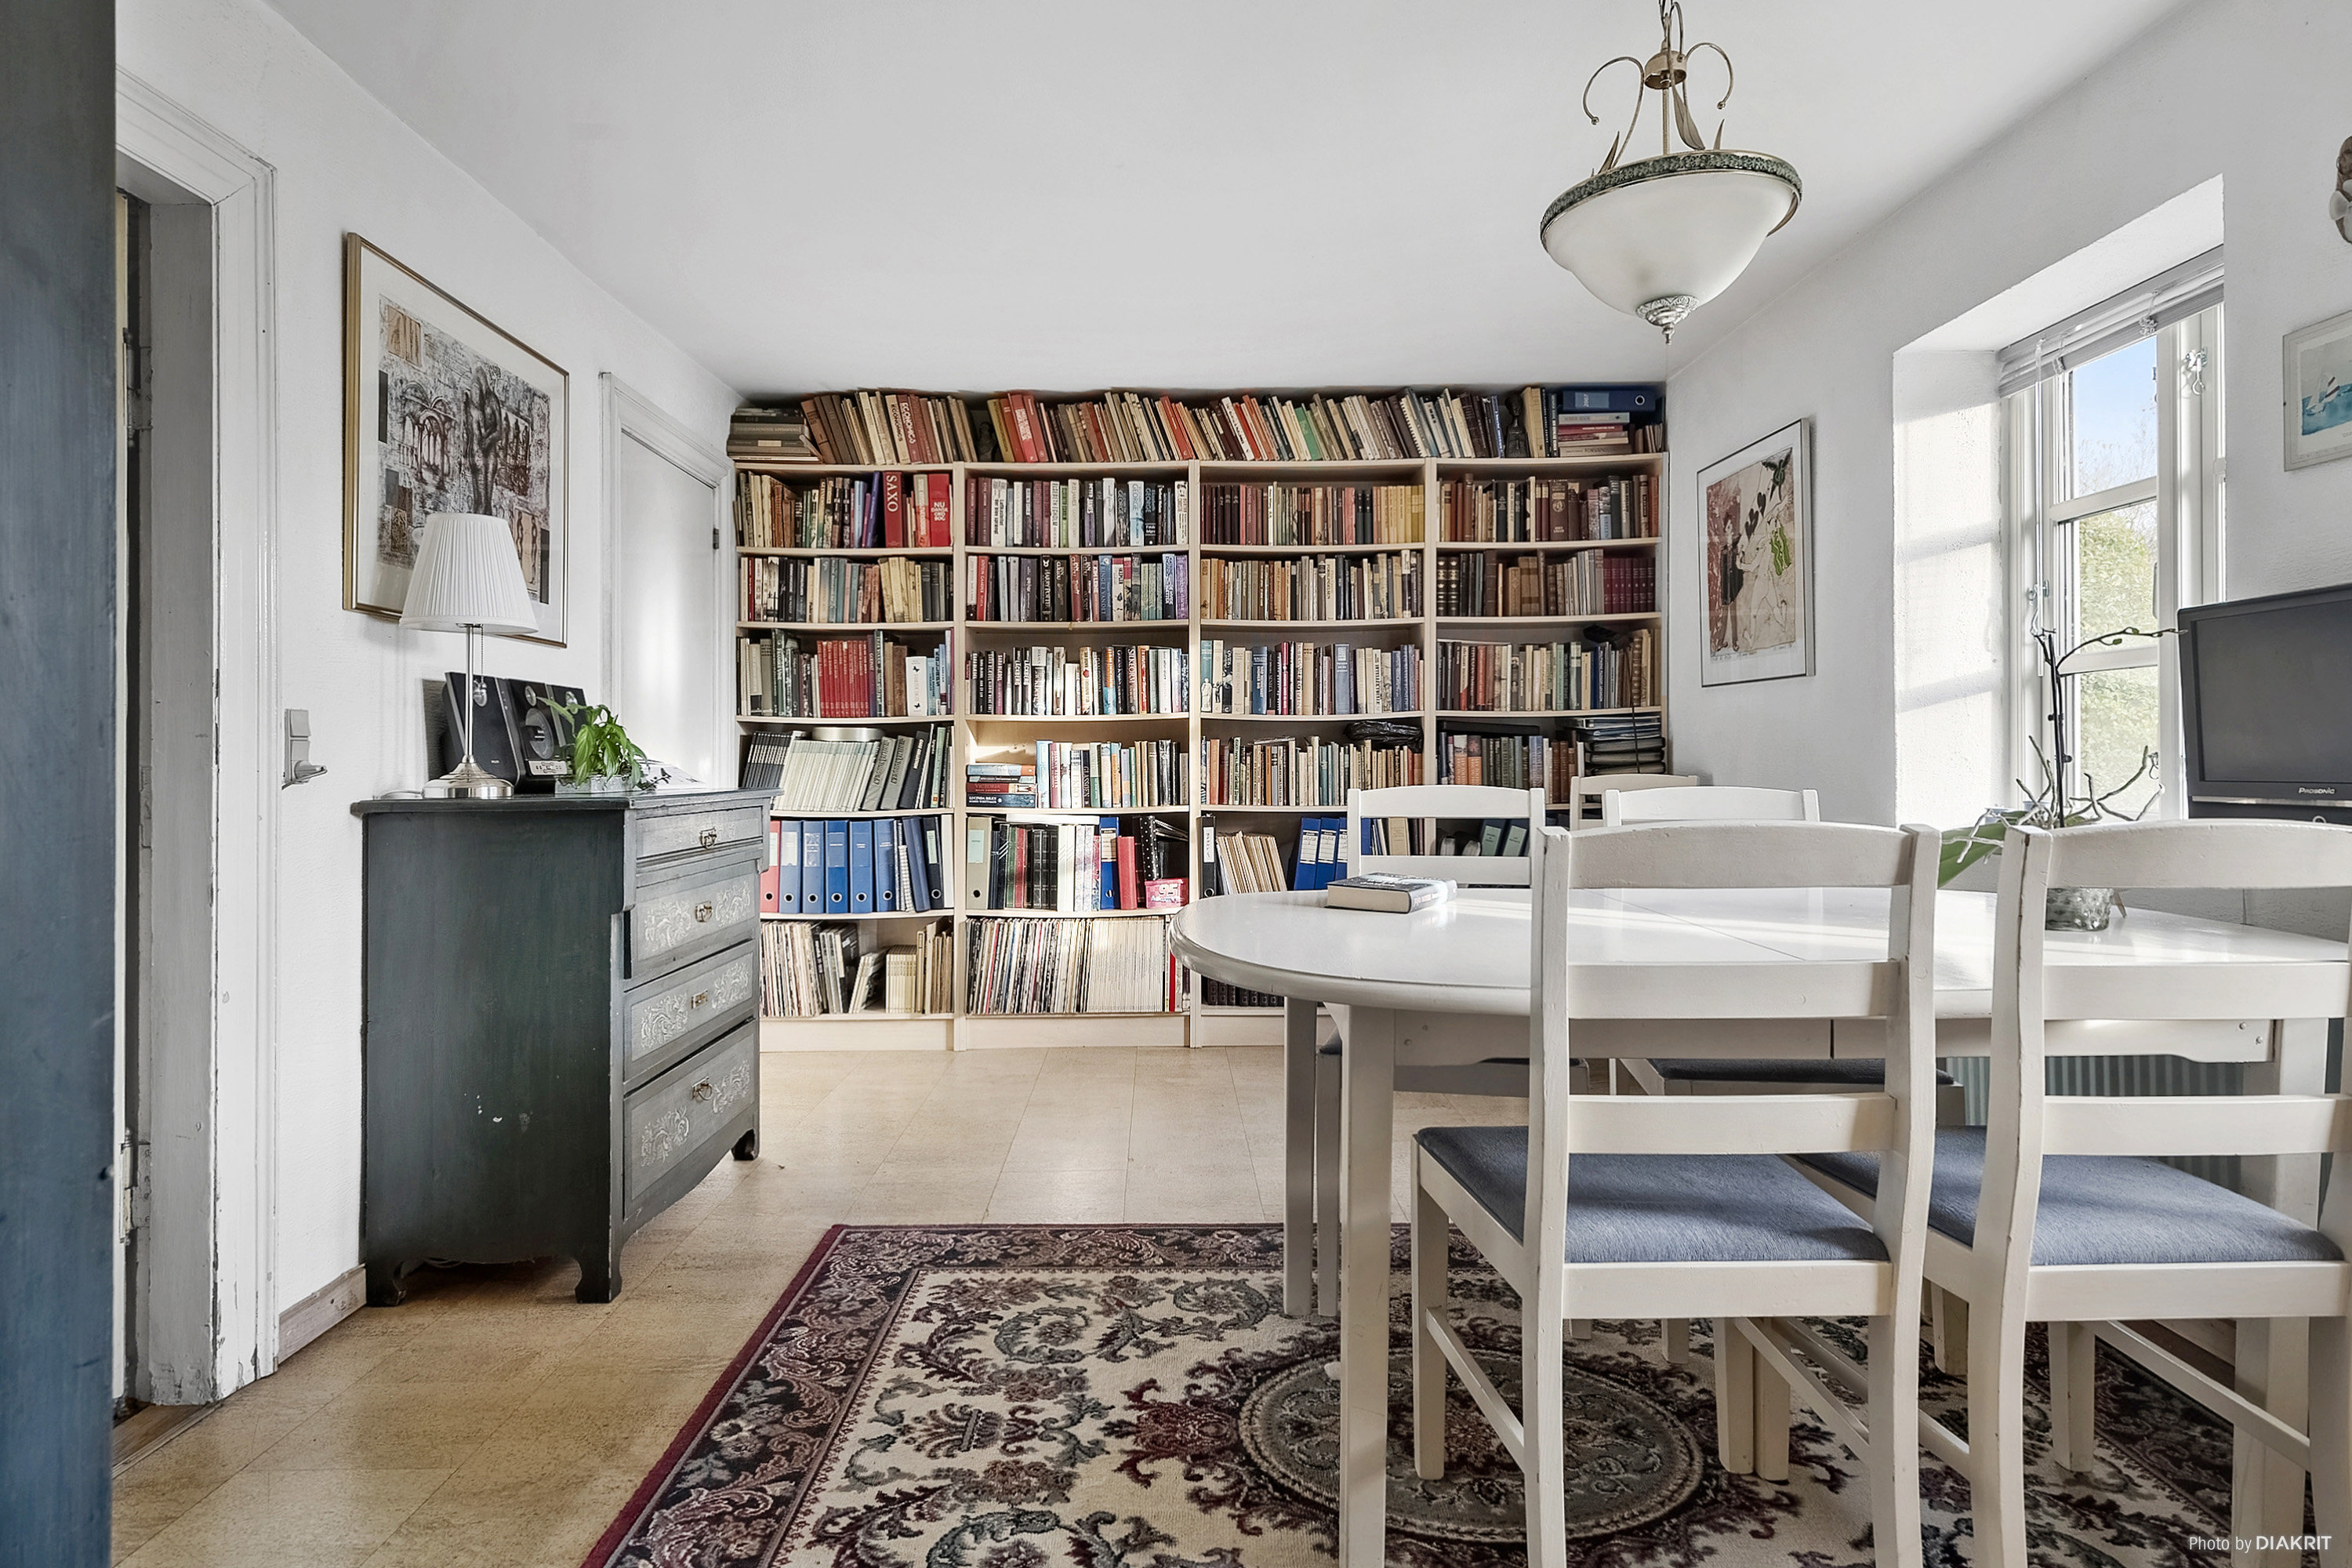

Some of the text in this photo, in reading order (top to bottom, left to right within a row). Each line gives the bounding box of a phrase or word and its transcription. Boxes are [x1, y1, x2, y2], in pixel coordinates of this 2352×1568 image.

[891, 404, 903, 442] ECONOMICS
[902, 401, 916, 444] ECONOMICS
[886, 475, 898, 513] SAXO
[1159, 884, 1179, 896] 95
